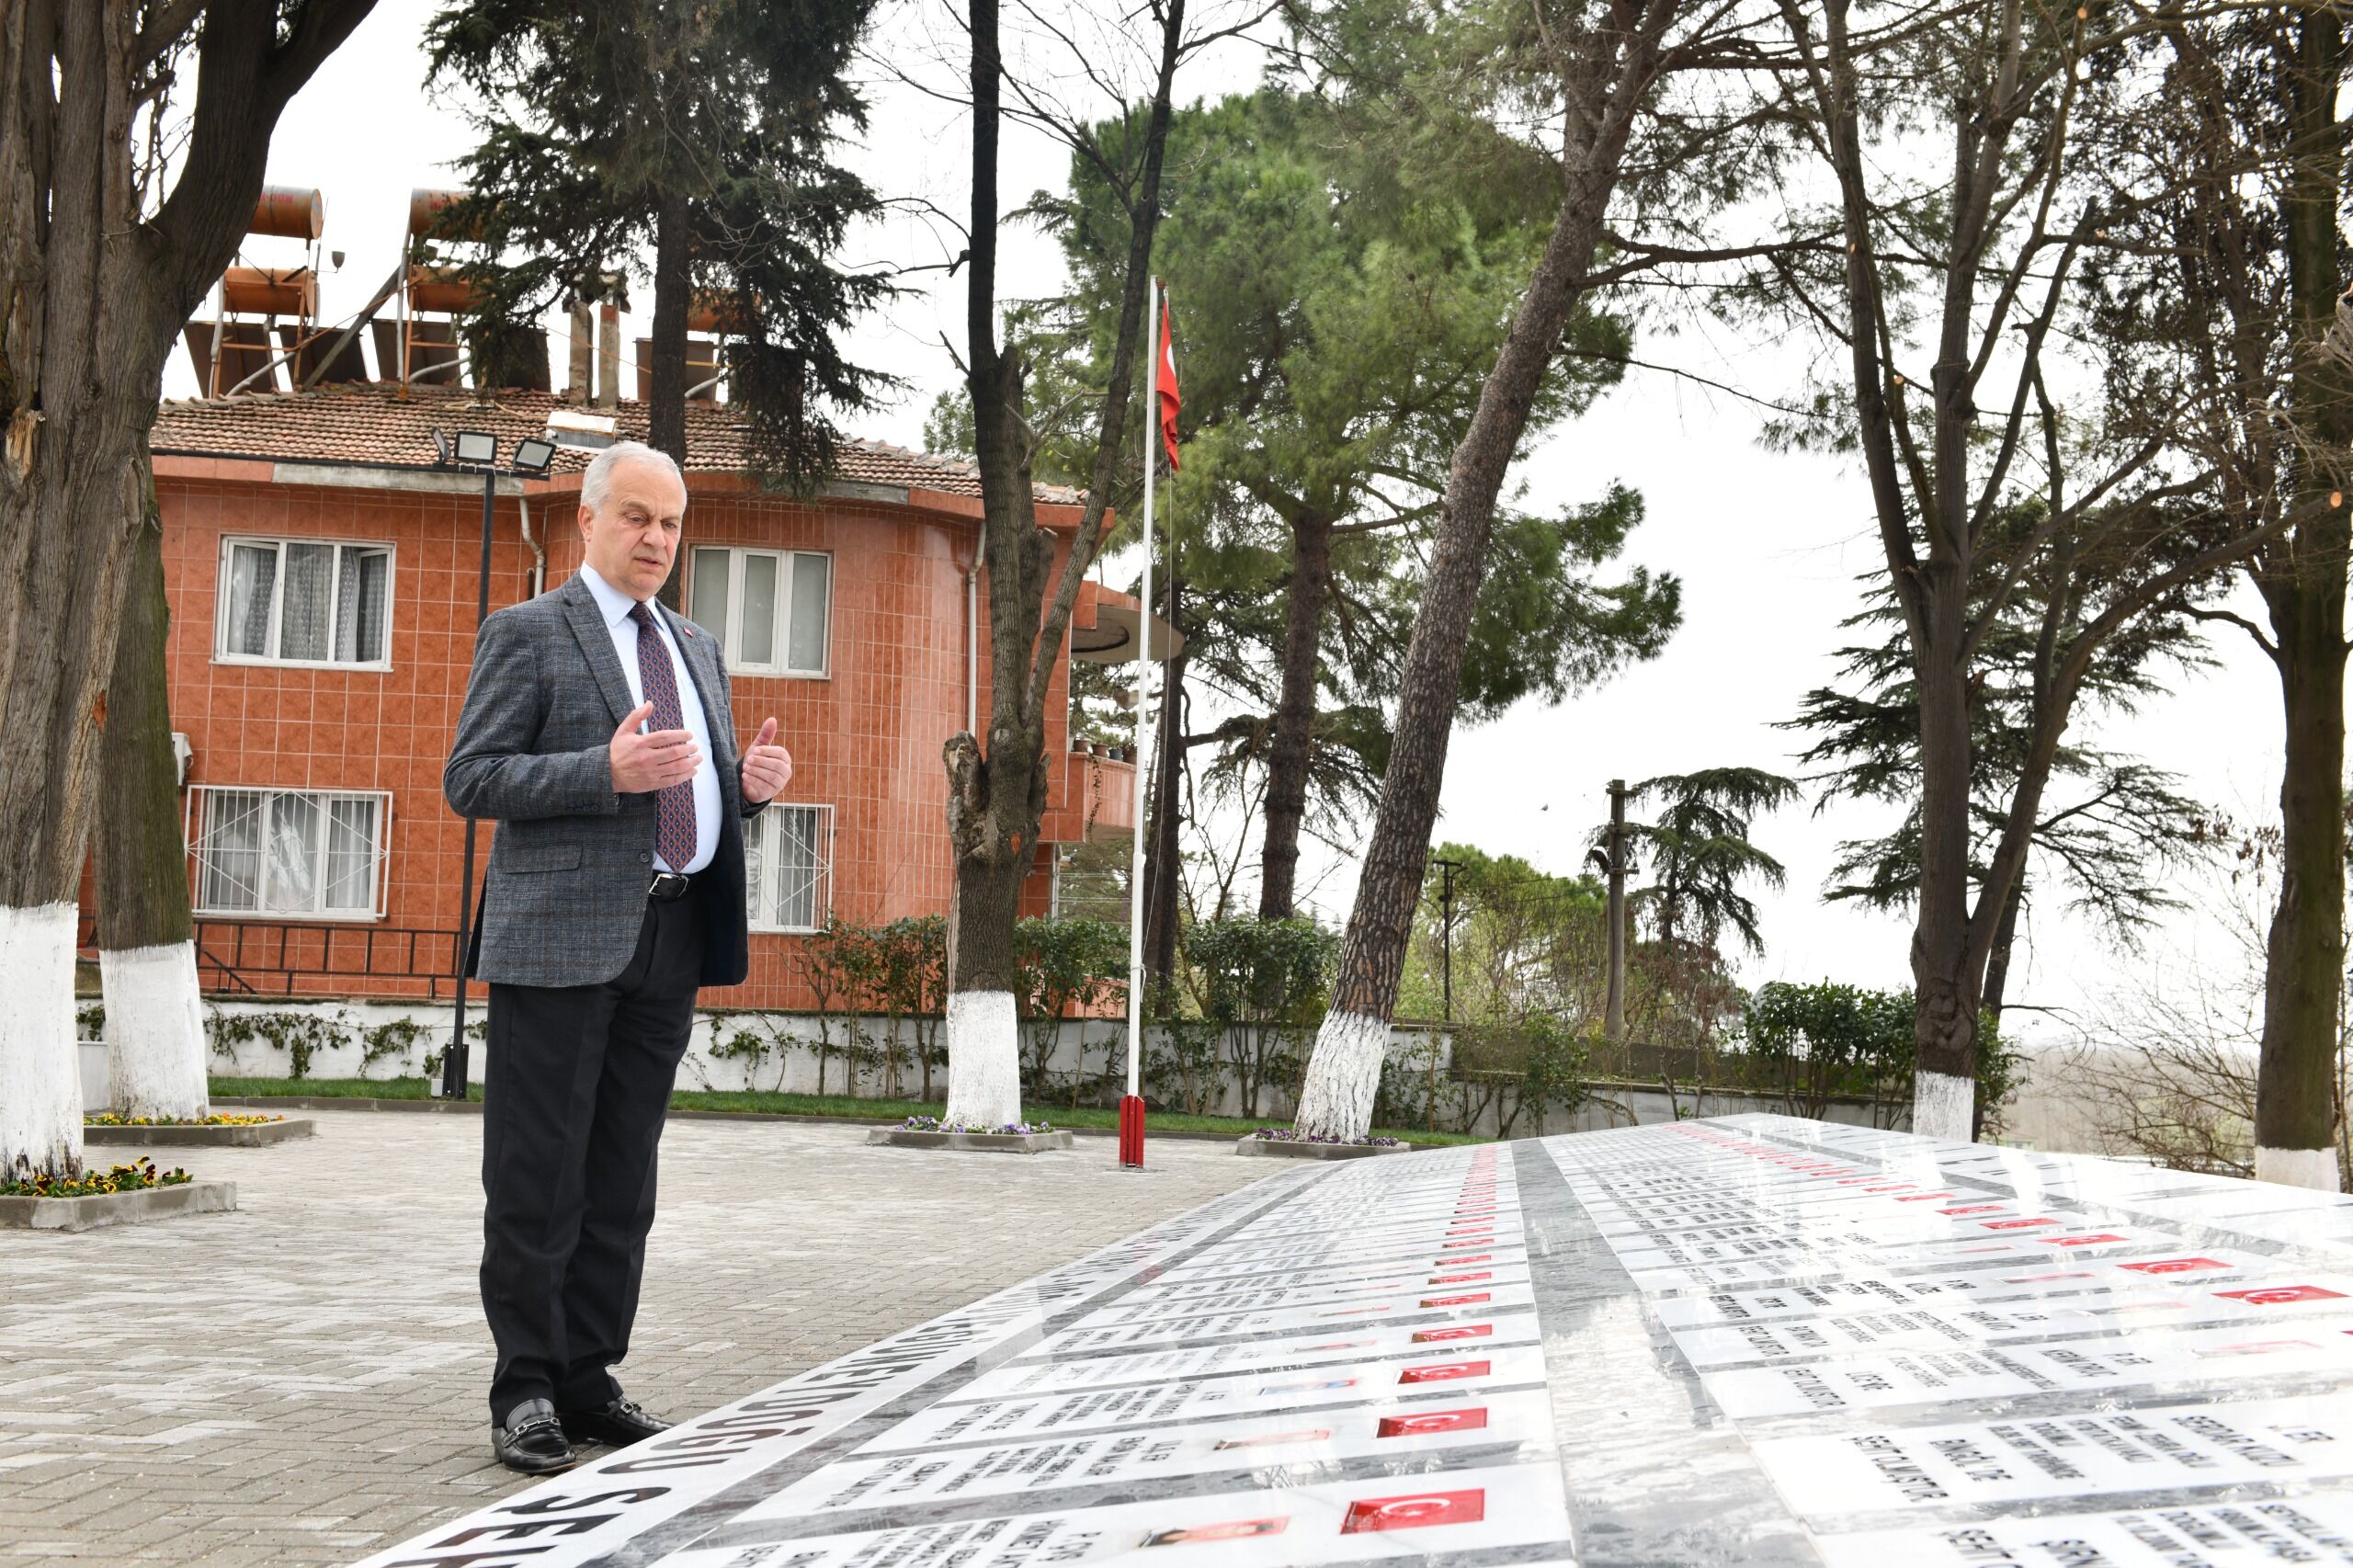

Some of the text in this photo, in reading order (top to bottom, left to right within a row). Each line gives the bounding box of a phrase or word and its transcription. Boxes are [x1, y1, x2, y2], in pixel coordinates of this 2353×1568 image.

[597, 1327, 996, 1475] GÜNEYDOĞU
[1849, 1435, 1903, 1454] ŞEHİT
[2170, 1415, 2296, 1467] SERDAR KUZU
[1939, 1529, 2014, 1560] ŞEHİT
